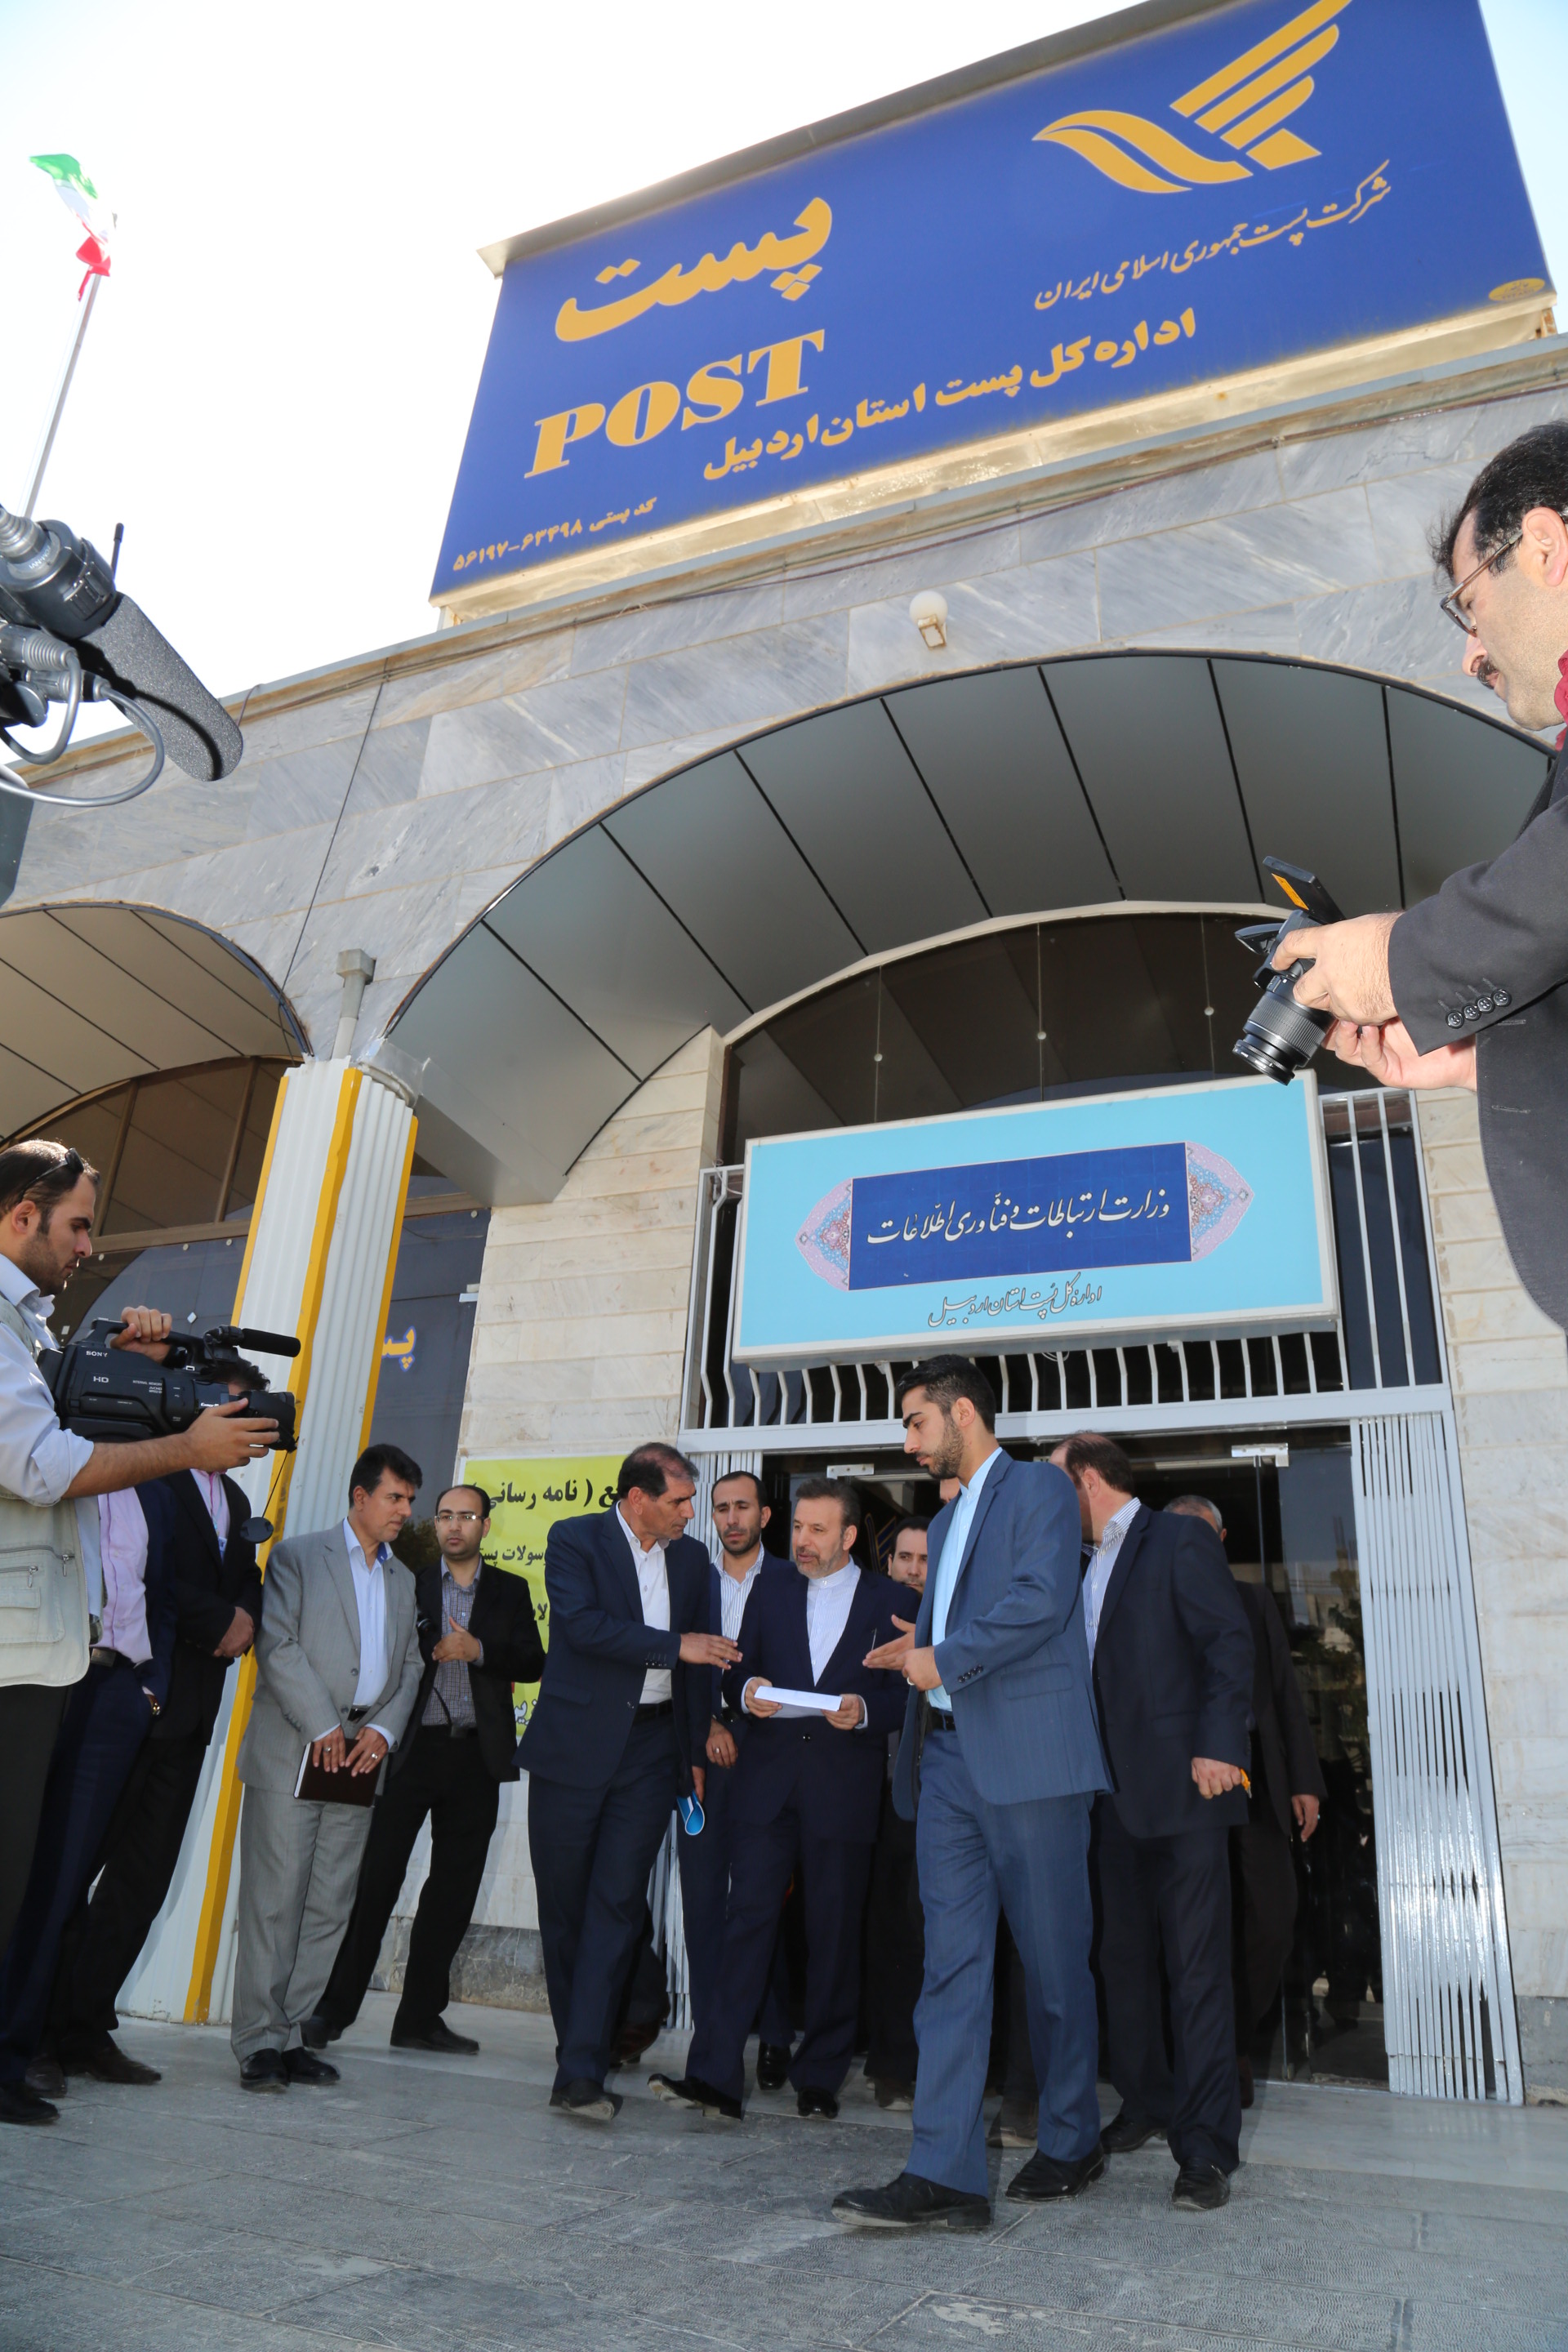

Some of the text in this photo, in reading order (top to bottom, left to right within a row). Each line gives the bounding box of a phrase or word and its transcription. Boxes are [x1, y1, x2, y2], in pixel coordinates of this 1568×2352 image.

[1035, 159, 1392, 310] شرکت پست جمهوری اسلامی ایران
[555, 197, 832, 342] پست
[523, 329, 825, 479] POST
[703, 307, 1196, 480] اداره کل پست استان اردبیل
[590, 508, 630, 532] پستی
[634, 497, 657, 515] کد
[1009, 1205, 1020, 1219] و
[1009, 1189, 1107, 1239] ارتباطات
[1098, 1189, 1169, 1223] وزارت
[928, 1295, 989, 1327] اردبیل
[987, 1287, 1026, 1316] استان
[1050, 1272, 1081, 1313] کل
